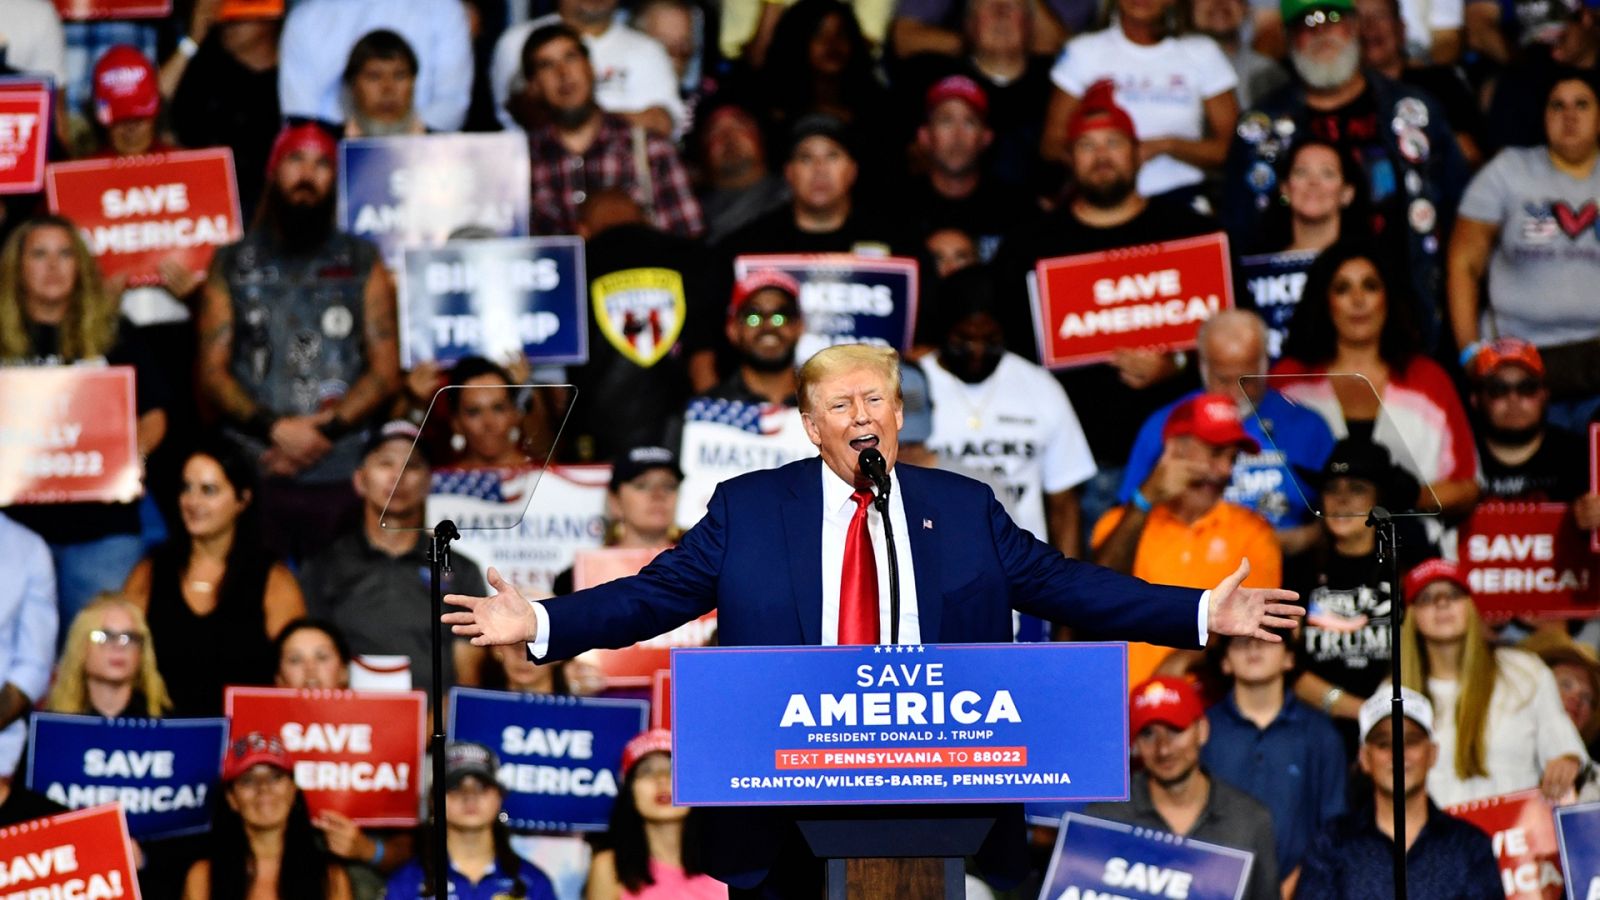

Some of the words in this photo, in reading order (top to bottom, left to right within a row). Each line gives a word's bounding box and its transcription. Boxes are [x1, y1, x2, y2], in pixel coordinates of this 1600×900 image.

[102, 183, 189, 219] SAVE
[800, 281, 894, 317] IKERS
[1093, 268, 1181, 305] SAVE
[433, 311, 561, 348] TRMP
[1059, 294, 1219, 339] AMERICA!
[1468, 534, 1554, 562] SAVE
[1305, 625, 1393, 655] TRUM
[856, 663, 944, 687] SAVE
[779, 690, 1022, 727] AMERICA
[281, 721, 373, 754] SAVE
[501, 725, 594, 760] SAVE
[808, 732, 876, 743] PRESIDENT
[880, 731, 933, 742] DONALD
[937, 731, 948, 741] J.
[951, 730, 994, 740] TRUMP
[84, 748, 175, 779] SAVE
[781, 753, 819, 765] TEXT
[824, 752, 943, 764] PENNSYLVANIA
[948, 752, 968, 763] TO
[973, 751, 1021, 763] 88022
[293, 760, 410, 792] ERICA!
[495, 762, 619, 797] MERICA
[730, 774, 948, 789] SCRANTON/WILKES-BARRE,
[952, 773, 1072, 785] PENNSYLVANIA
[46, 782, 208, 814] AMERICA!
[1102, 856, 1193, 900] SAVE
